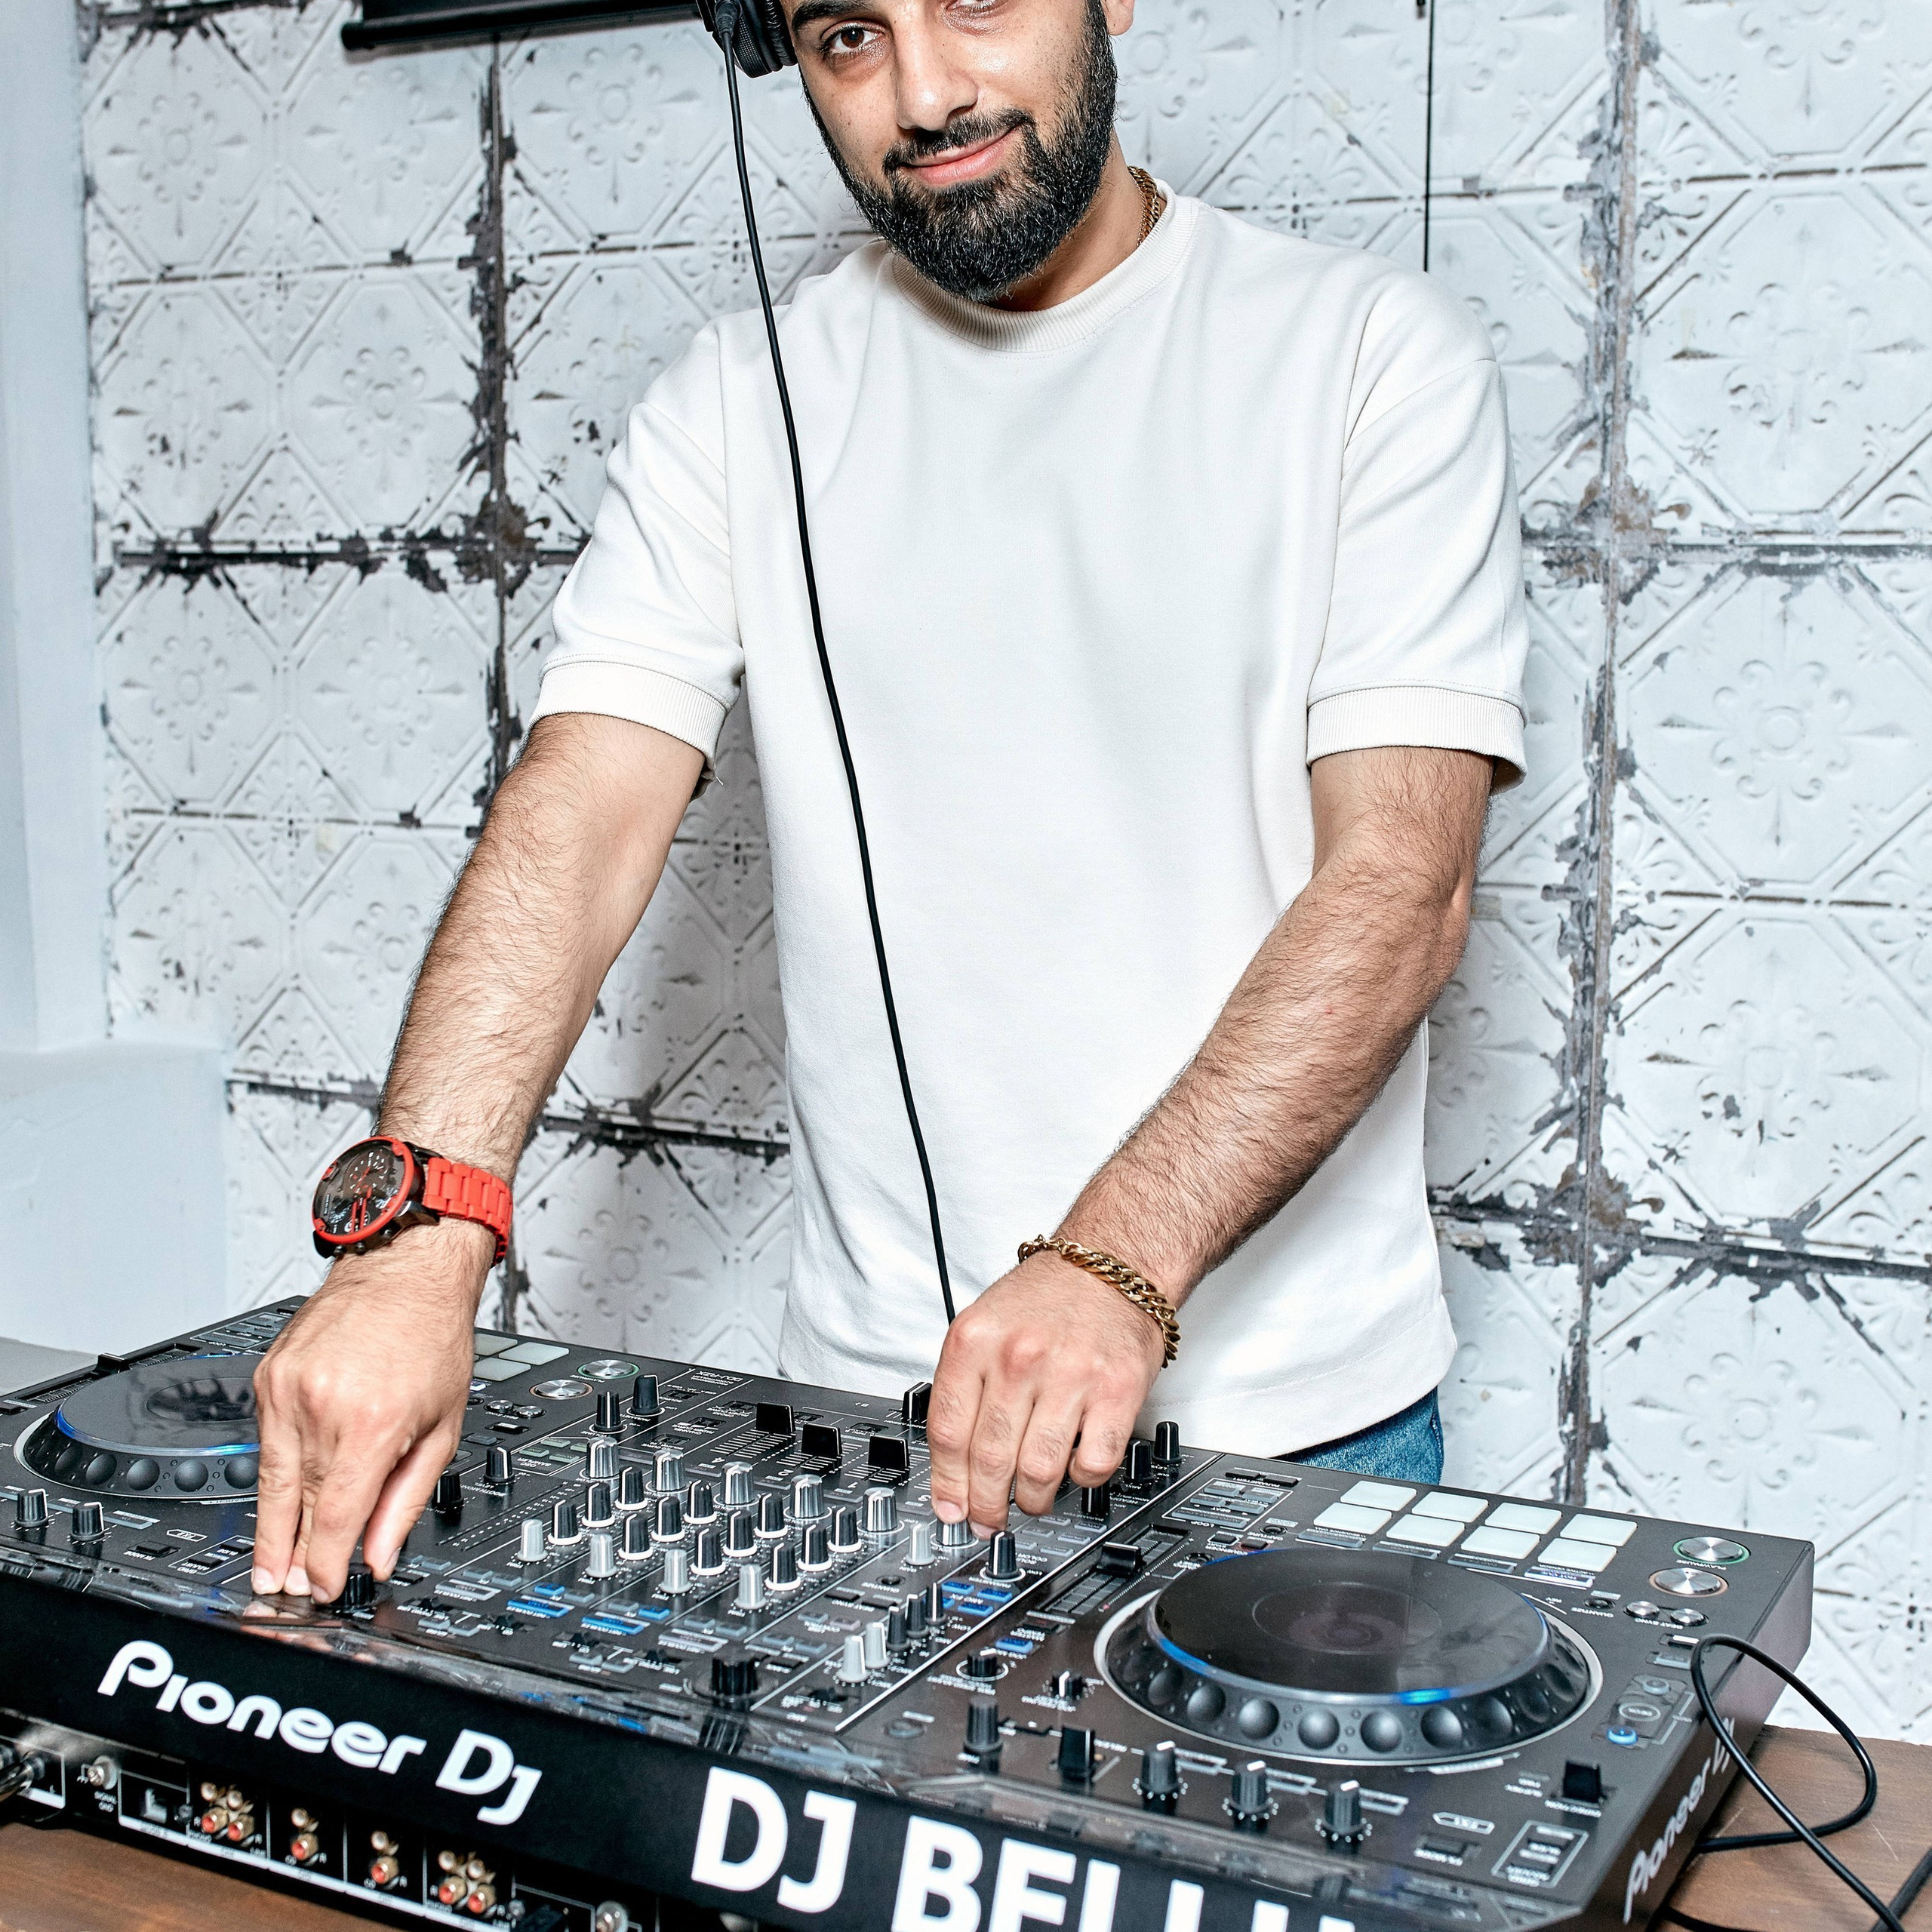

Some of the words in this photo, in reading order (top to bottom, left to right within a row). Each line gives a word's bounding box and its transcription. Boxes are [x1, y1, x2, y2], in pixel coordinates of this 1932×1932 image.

[695, 1371, 744, 1382] DDJ-RZX
[1247, 1532, 1284, 1541] CAPTURE
[1675, 1559, 1727, 1571] PLAY/PAUSE
[1571, 1607, 1614, 1617] QUANTIZE
[97, 1639, 427, 1775] Pioneer
[435, 1728, 543, 1826] DJ
[691, 1765, 857, 1914] DJ
